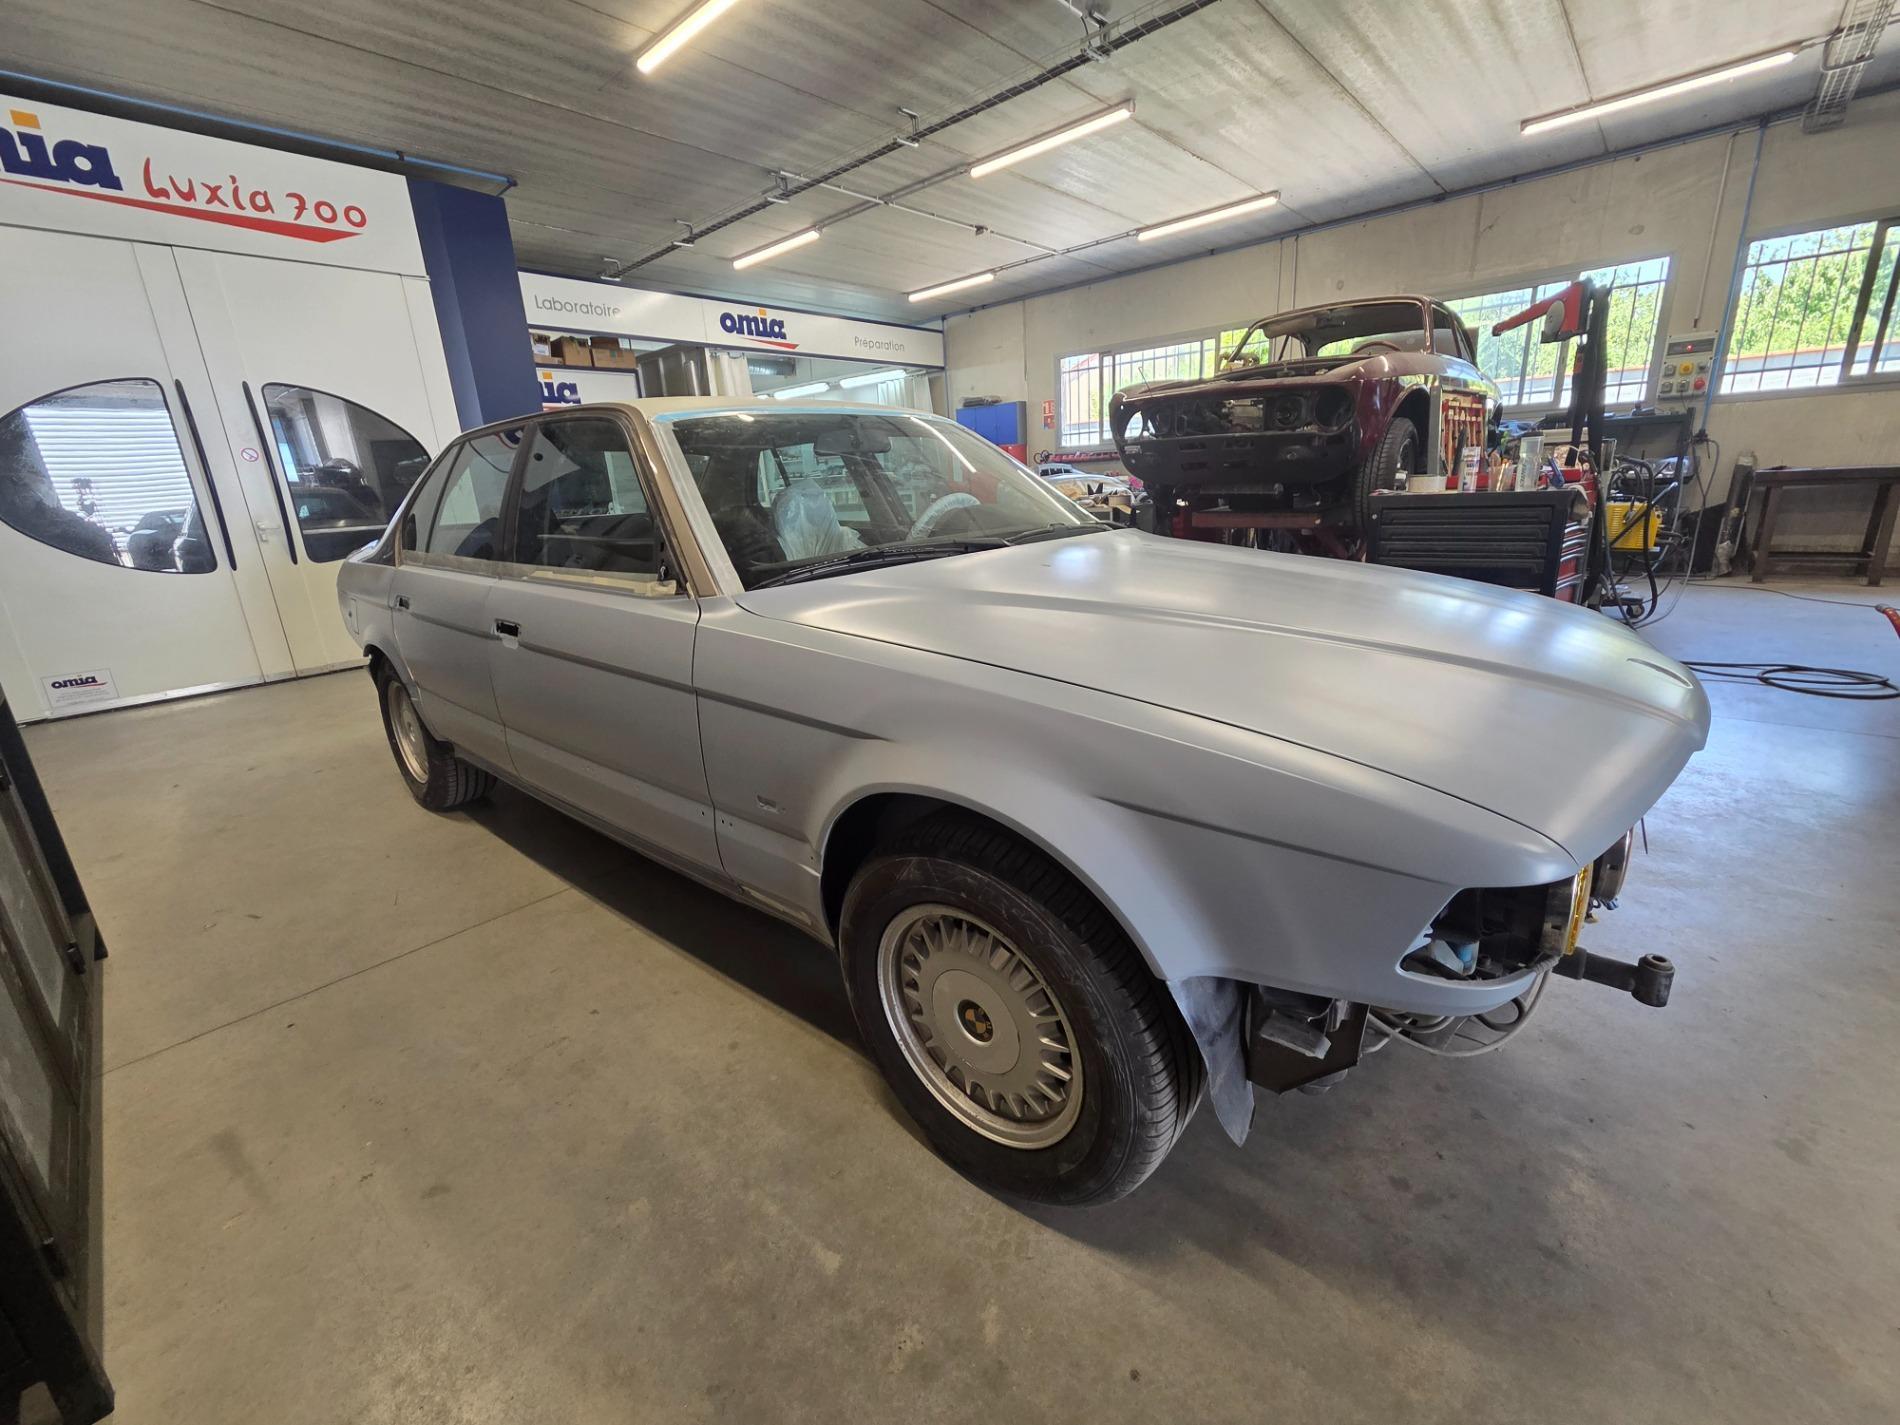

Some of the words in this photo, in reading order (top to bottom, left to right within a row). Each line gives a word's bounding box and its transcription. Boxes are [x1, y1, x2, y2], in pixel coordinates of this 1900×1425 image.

[143, 157, 275, 214] Luxia
[286, 192, 367, 228] 700
[534, 294, 622, 318] Laboratoire
[720, 307, 787, 340] omia
[854, 335, 906, 353] Preparation
[51, 674, 98, 689] omia
